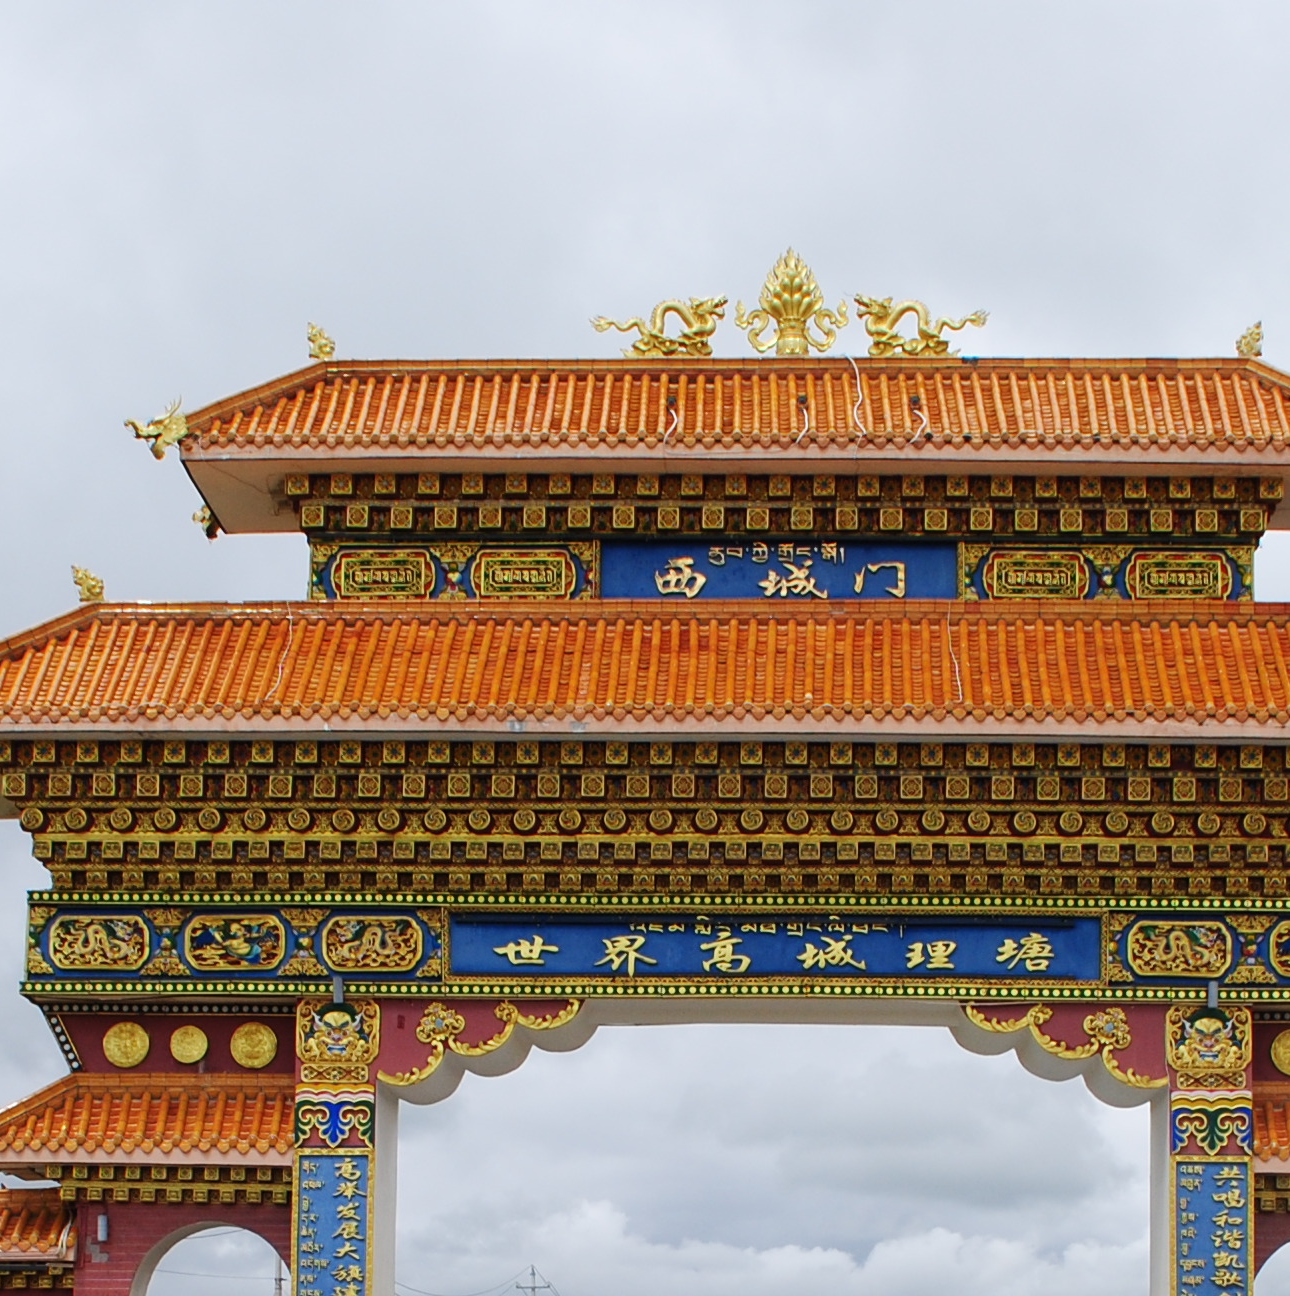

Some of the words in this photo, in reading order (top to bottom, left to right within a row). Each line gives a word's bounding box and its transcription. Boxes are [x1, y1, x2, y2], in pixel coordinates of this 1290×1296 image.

[655, 556, 906, 598] 西城门
[492, 933, 1056, 977] 世界高城理塘
